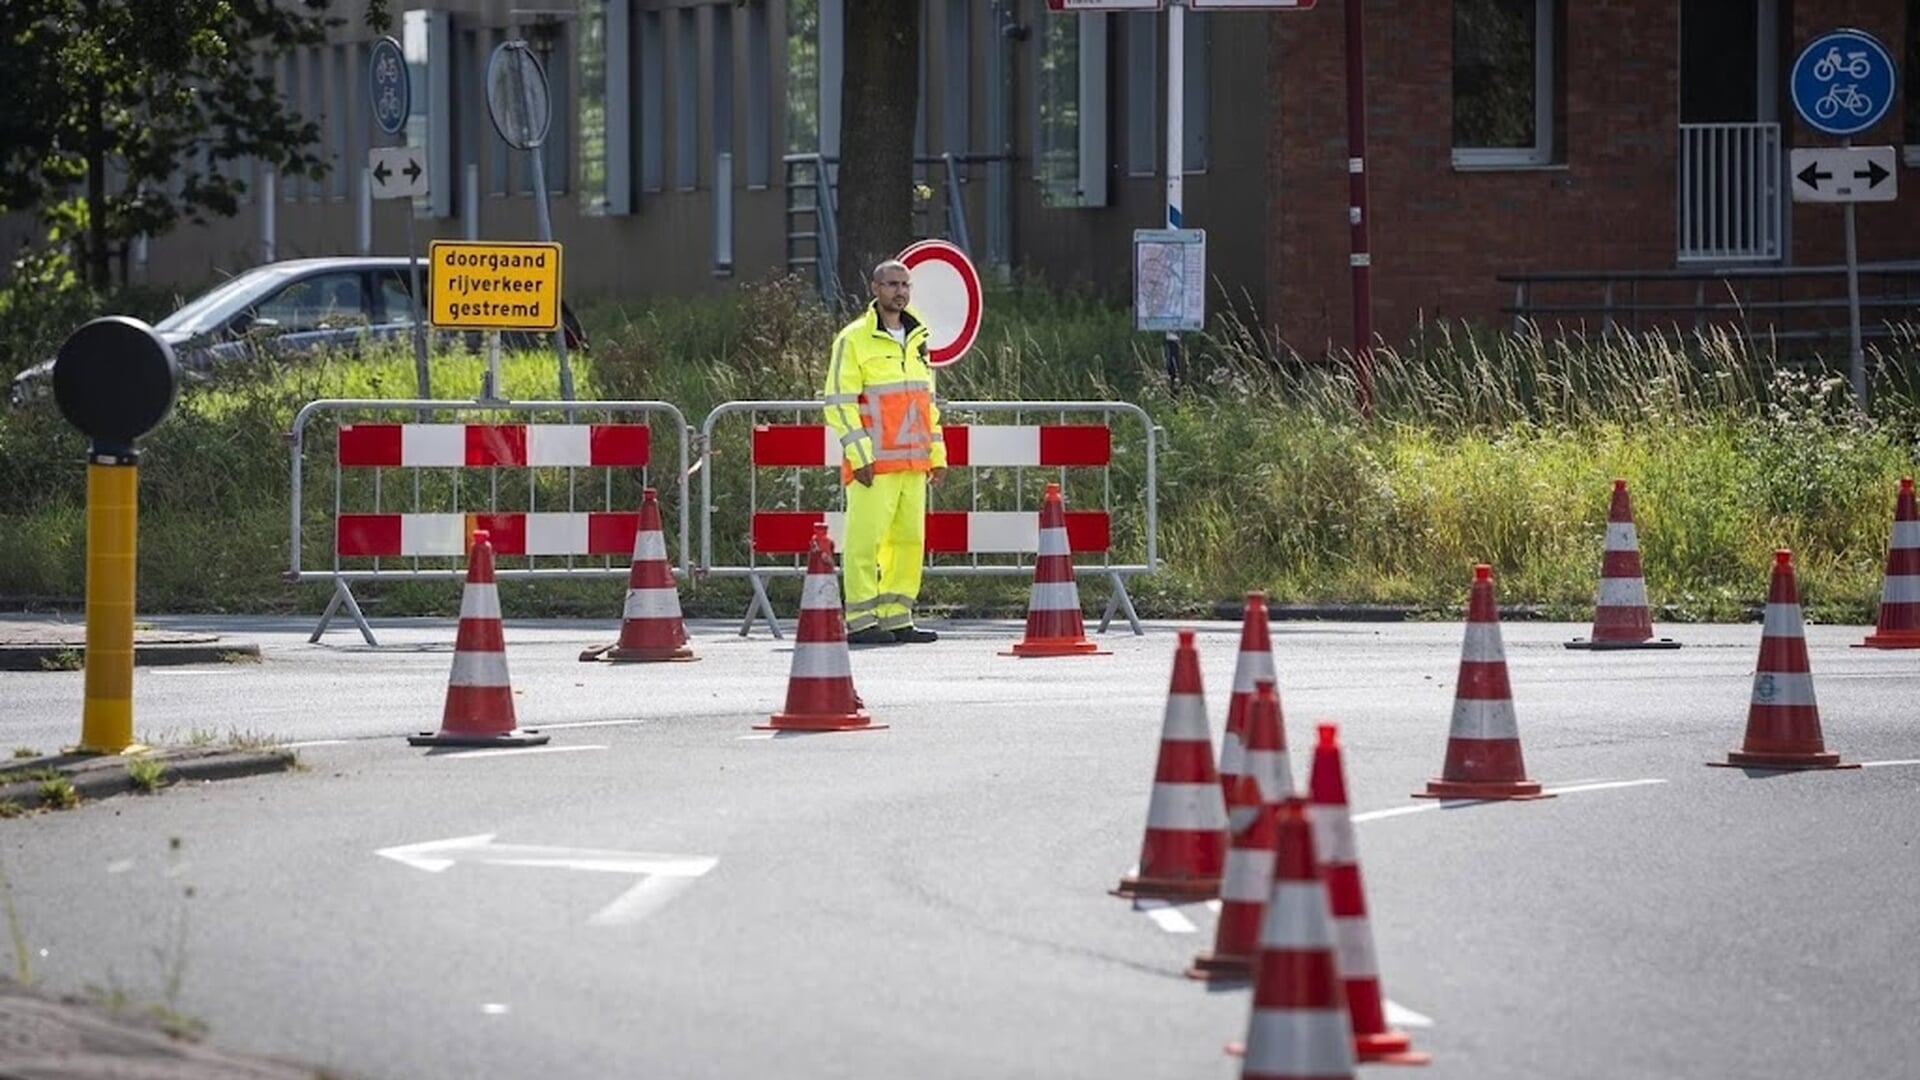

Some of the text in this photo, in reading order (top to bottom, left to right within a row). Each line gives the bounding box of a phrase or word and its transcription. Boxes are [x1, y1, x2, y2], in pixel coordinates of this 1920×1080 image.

[445, 250, 545, 271] doorgaand
[449, 275, 543, 296] rijverkeer
[449, 301, 540, 320] gestremd
